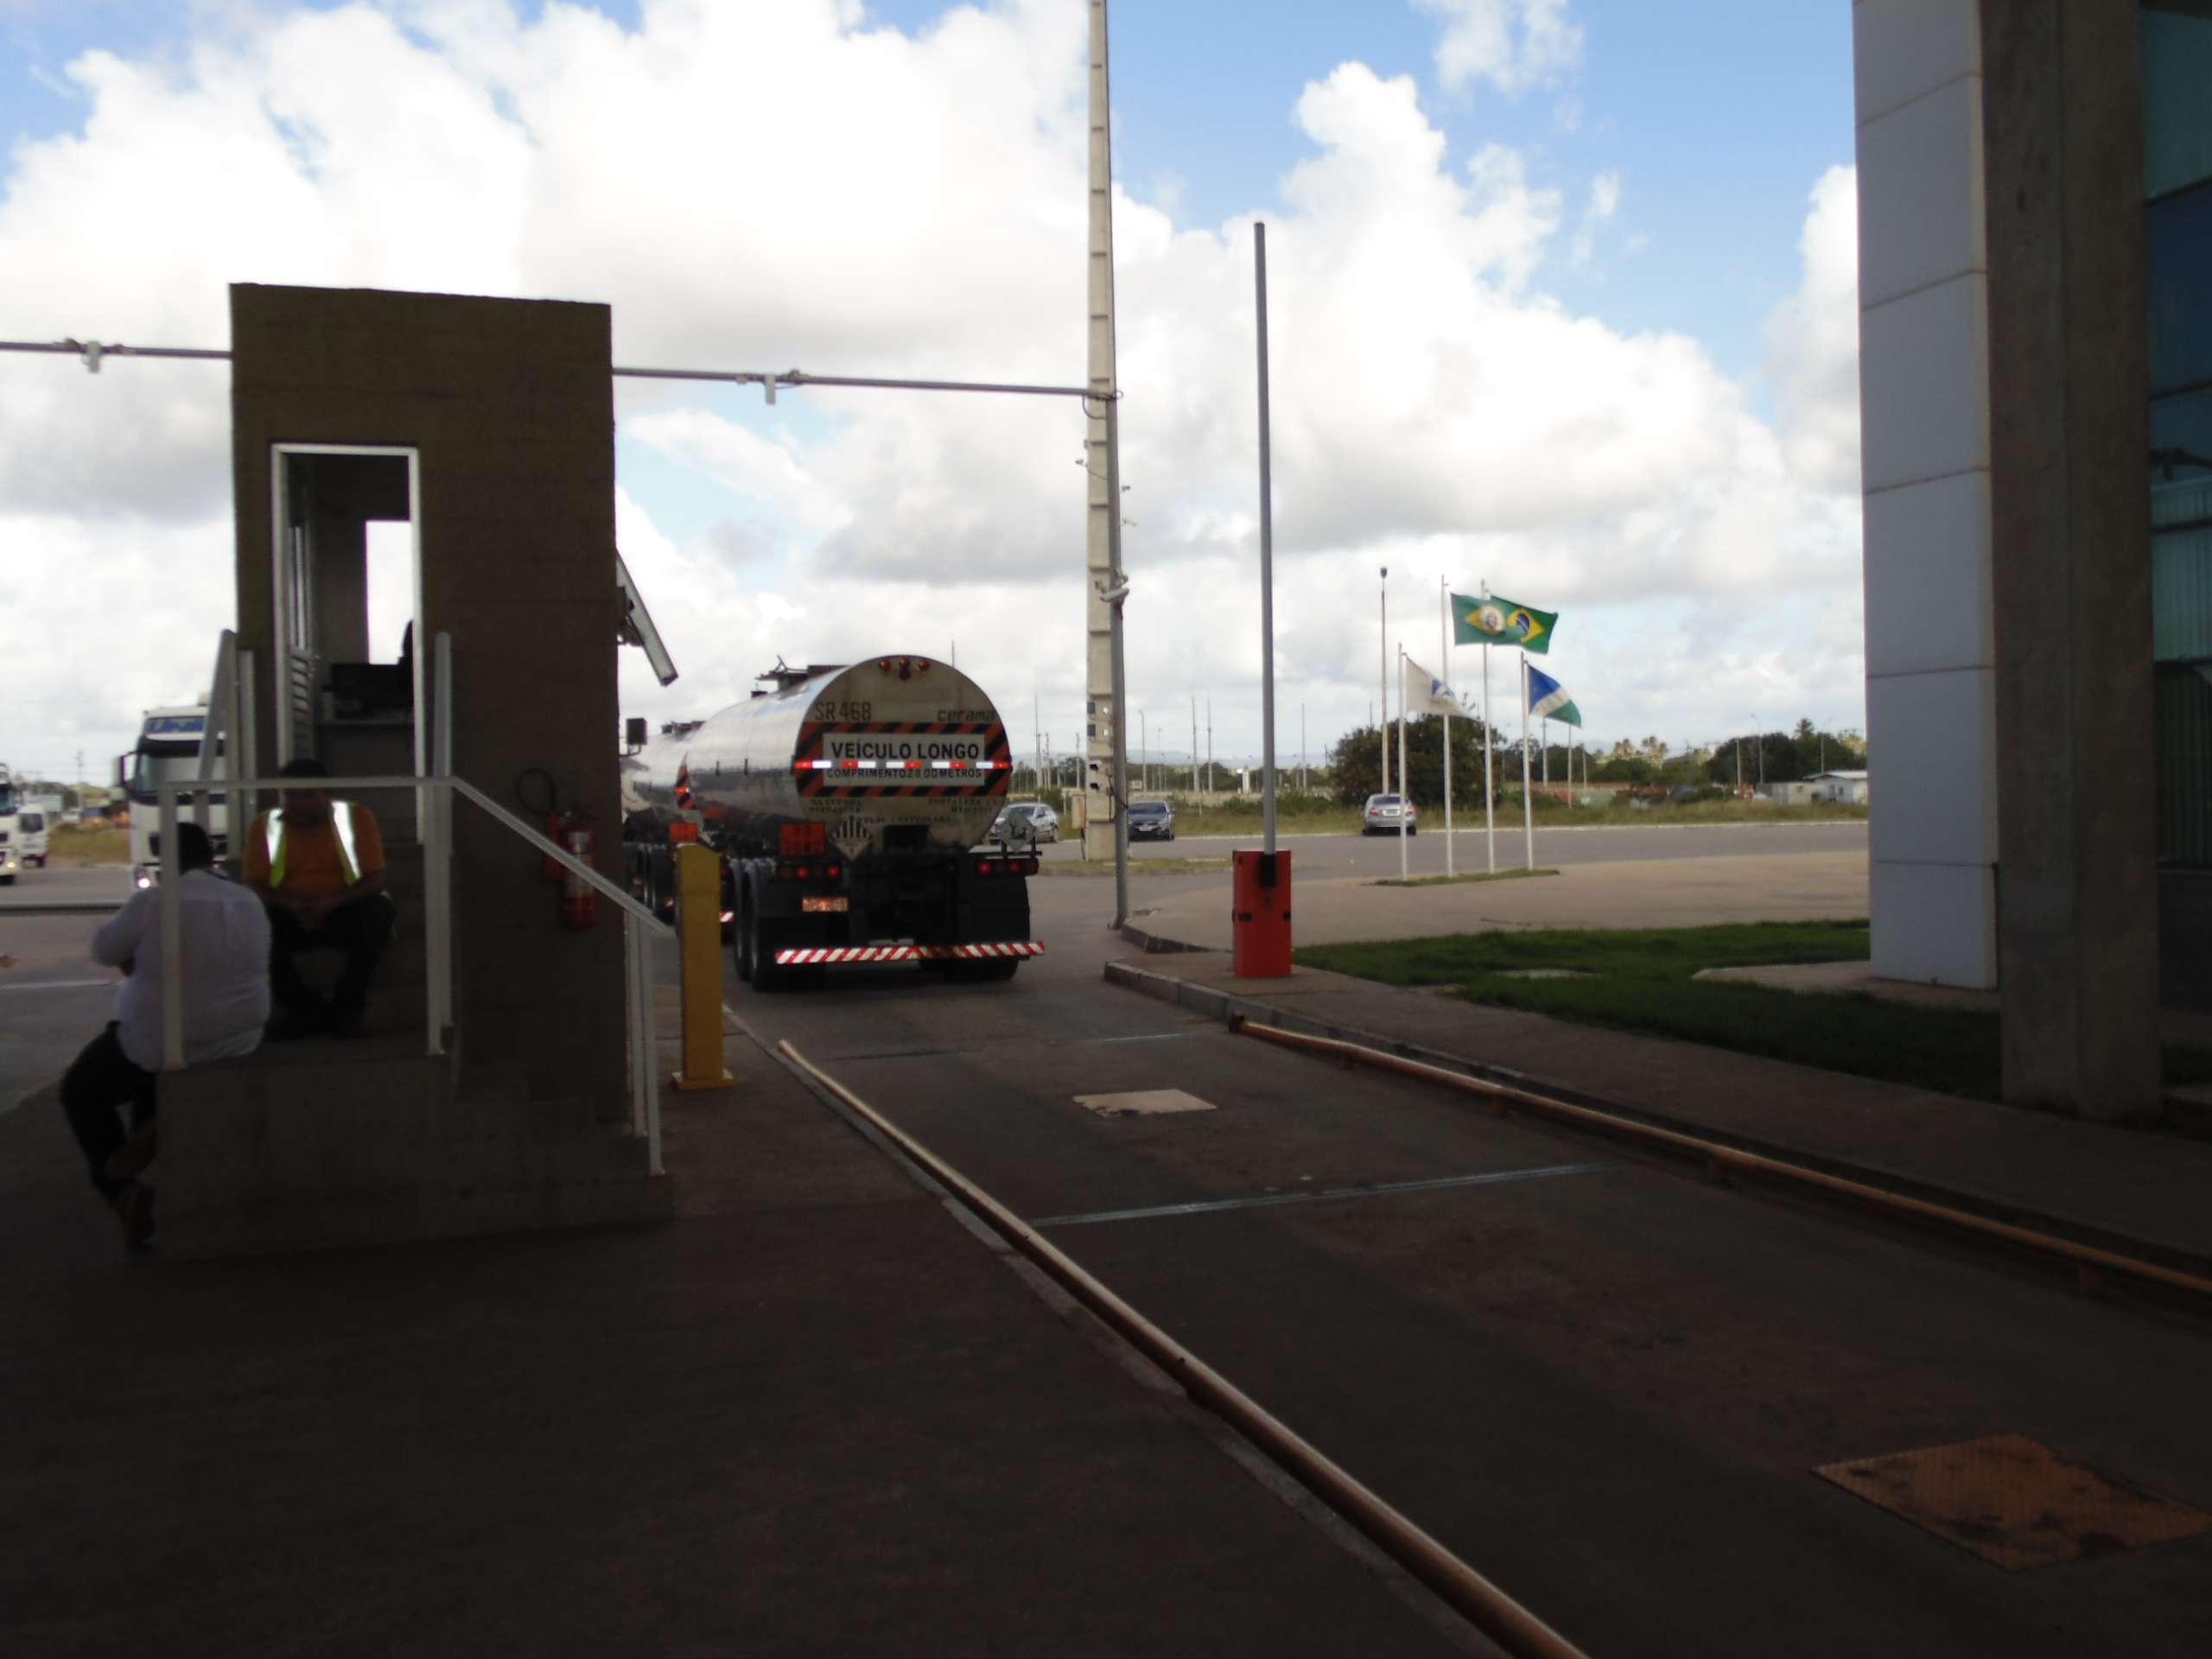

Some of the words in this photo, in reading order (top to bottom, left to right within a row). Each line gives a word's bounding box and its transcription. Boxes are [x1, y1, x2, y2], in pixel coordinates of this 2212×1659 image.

[815, 702, 835, 721] SR
[831, 741, 912, 760] VEÍCULO
[918, 743, 979, 760] LONGO
[826, 768, 906, 779] COMPRIMENTO
[939, 768, 982, 779] METROS
